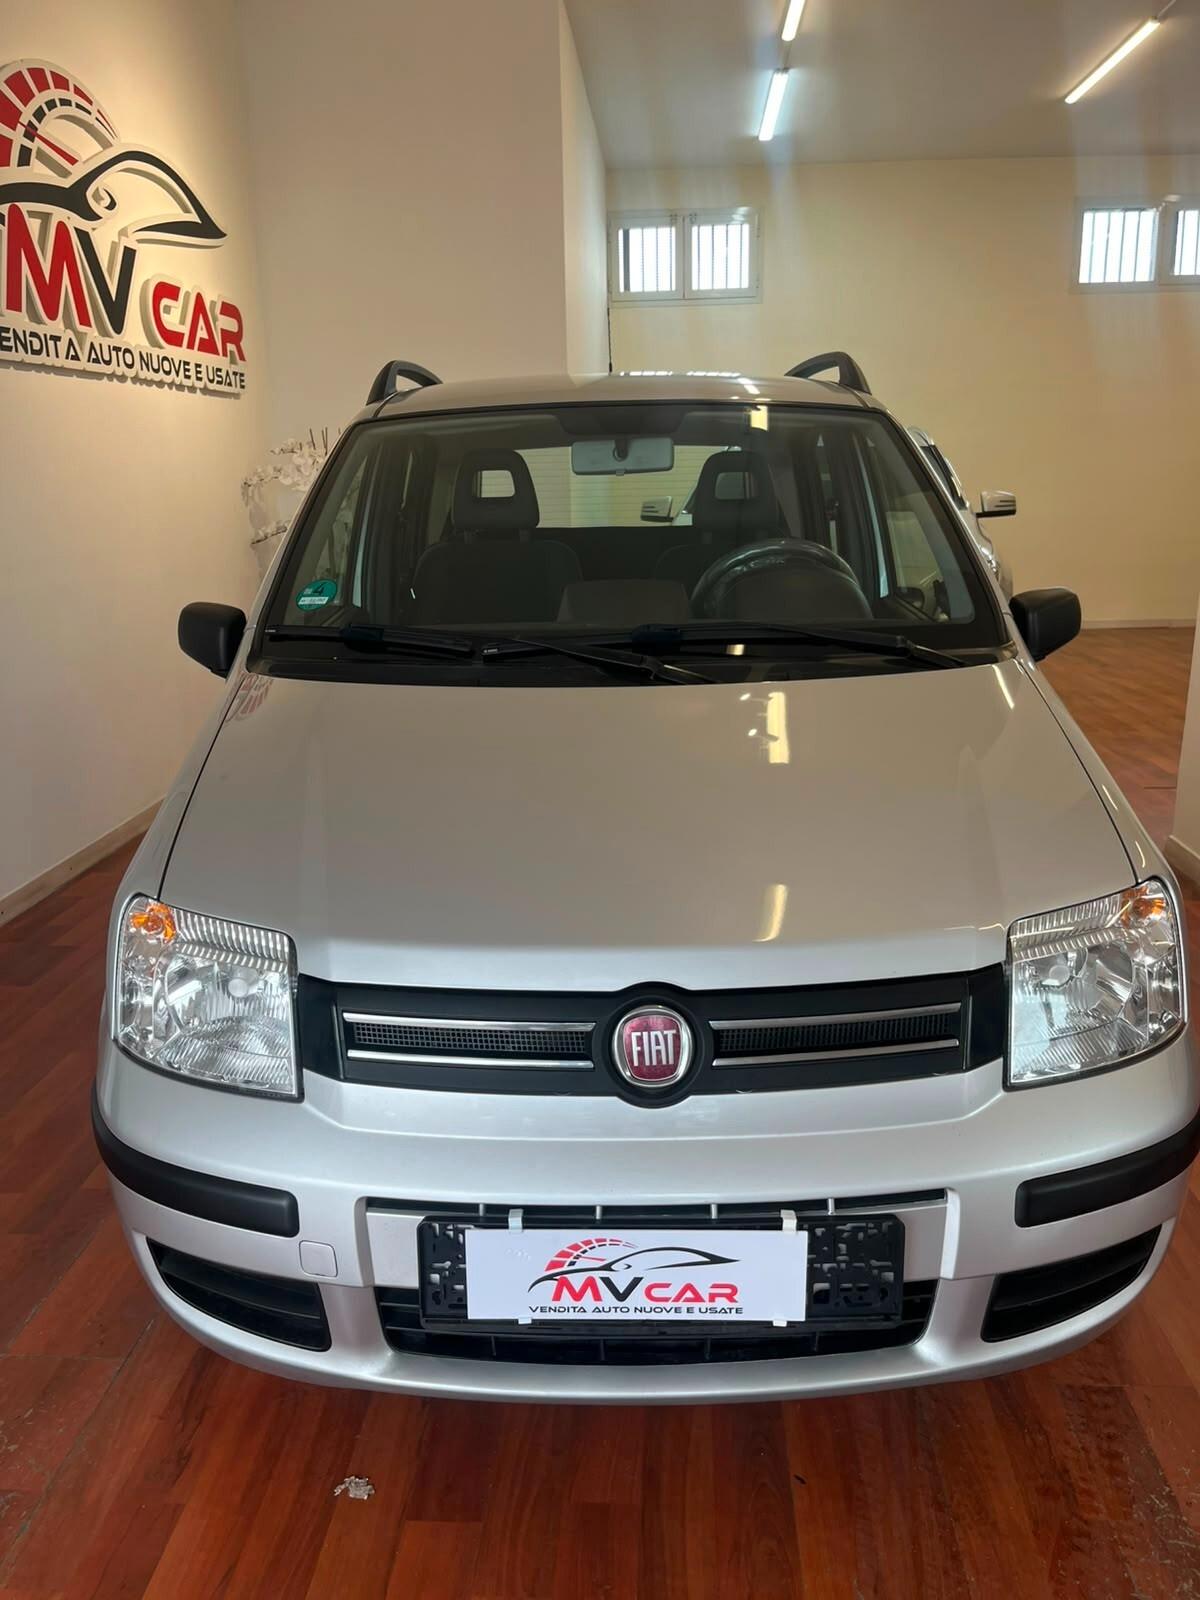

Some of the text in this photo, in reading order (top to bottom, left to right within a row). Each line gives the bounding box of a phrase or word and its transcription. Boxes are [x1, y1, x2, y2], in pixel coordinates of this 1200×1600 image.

[6, 203, 247, 362] MV CAR
[0, 326, 246, 389] ENDITA AUTO NUOVE E USATE
[631, 1029, 677, 1067] FIAT
[634, 1306, 682, 1314] NUOVE
[687, 1306, 695, 1314] E
